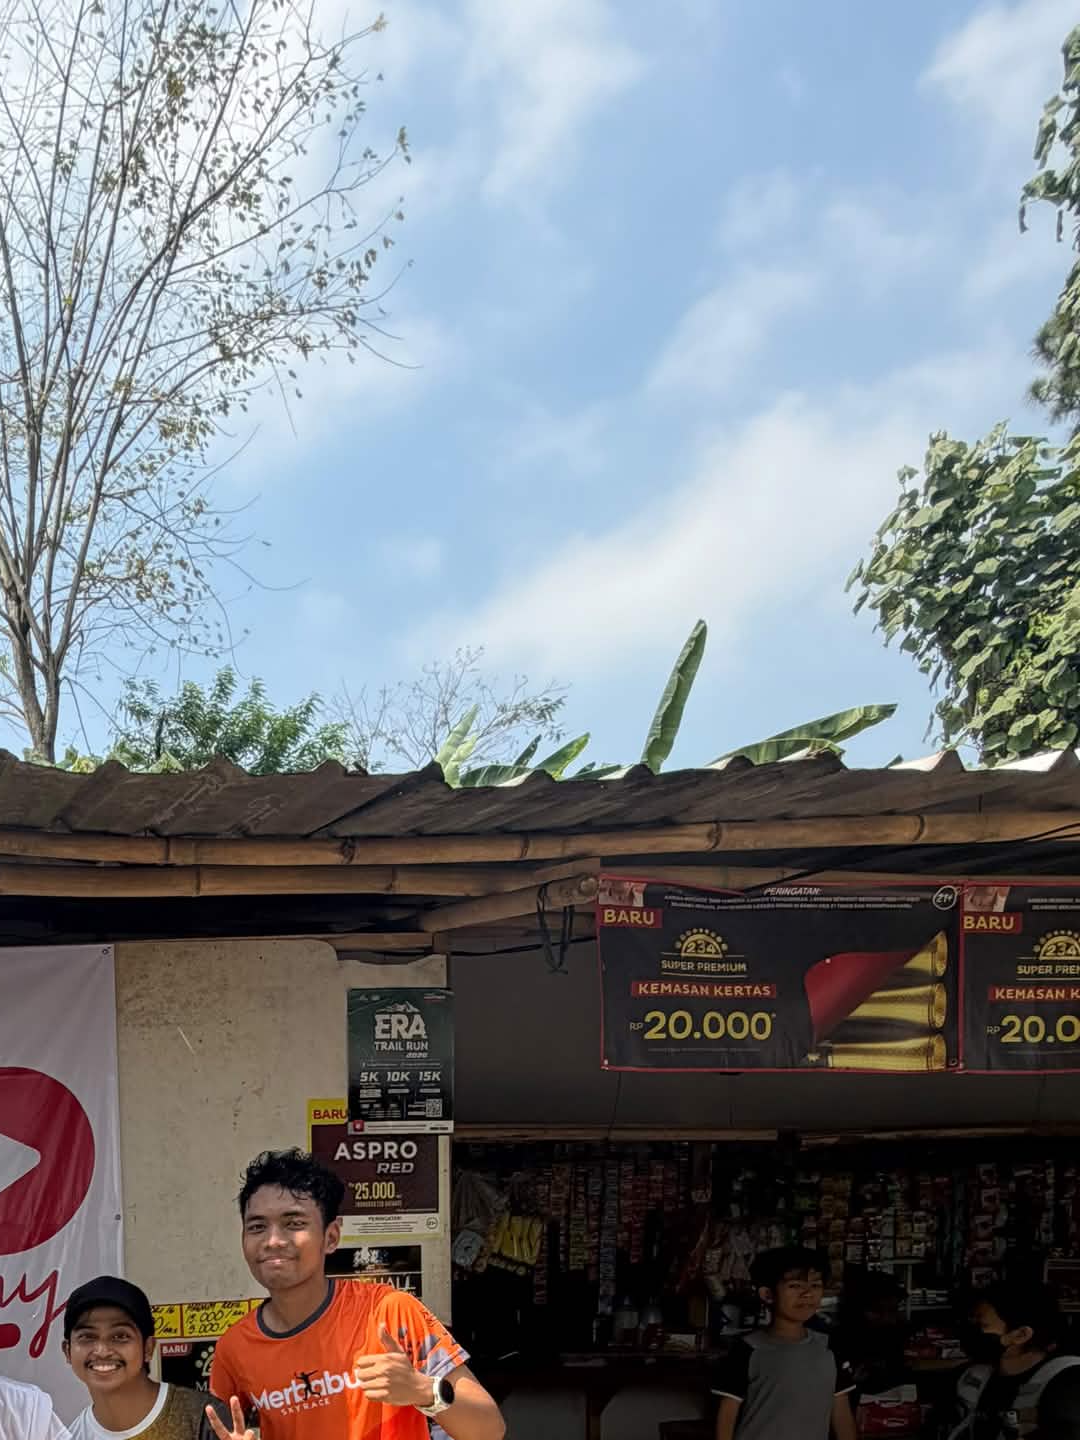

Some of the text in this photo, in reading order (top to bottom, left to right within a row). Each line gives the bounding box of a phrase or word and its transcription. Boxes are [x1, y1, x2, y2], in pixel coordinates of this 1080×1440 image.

[603, 909, 655, 925] BARU
[963, 915, 1015, 930] BARU
[686, 941, 717, 954] 234
[1045, 943, 1078, 956] 234
[661, 959, 747, 972] SUPER PREMIUM
[1016, 964, 1080, 975] SUPER PREM
[638, 983, 771, 996] KEMASAN KERTAS
[994, 988, 1066, 1000] KEMASAN
[375, 1014, 428, 1039] ERA
[629, 1010, 772, 1040] RP 20.000
[986, 1015, 1080, 1043] RP 20.0
[374, 1041, 429, 1051] TRAIL RUN
[360, 1071, 379, 1082] 5K
[386, 1071, 411, 1082] 10K
[419, 1071, 441, 1082] 15K
[312, 1109, 348, 1120] BARU
[333, 1140, 418, 1160] ASPRO
[376, 1162, 415, 1175] RED
[354, 1181, 396, 1200] 25.000
[162, 1343, 188, 1354] BARU
[250, 1368, 361, 1412] Merbabu
